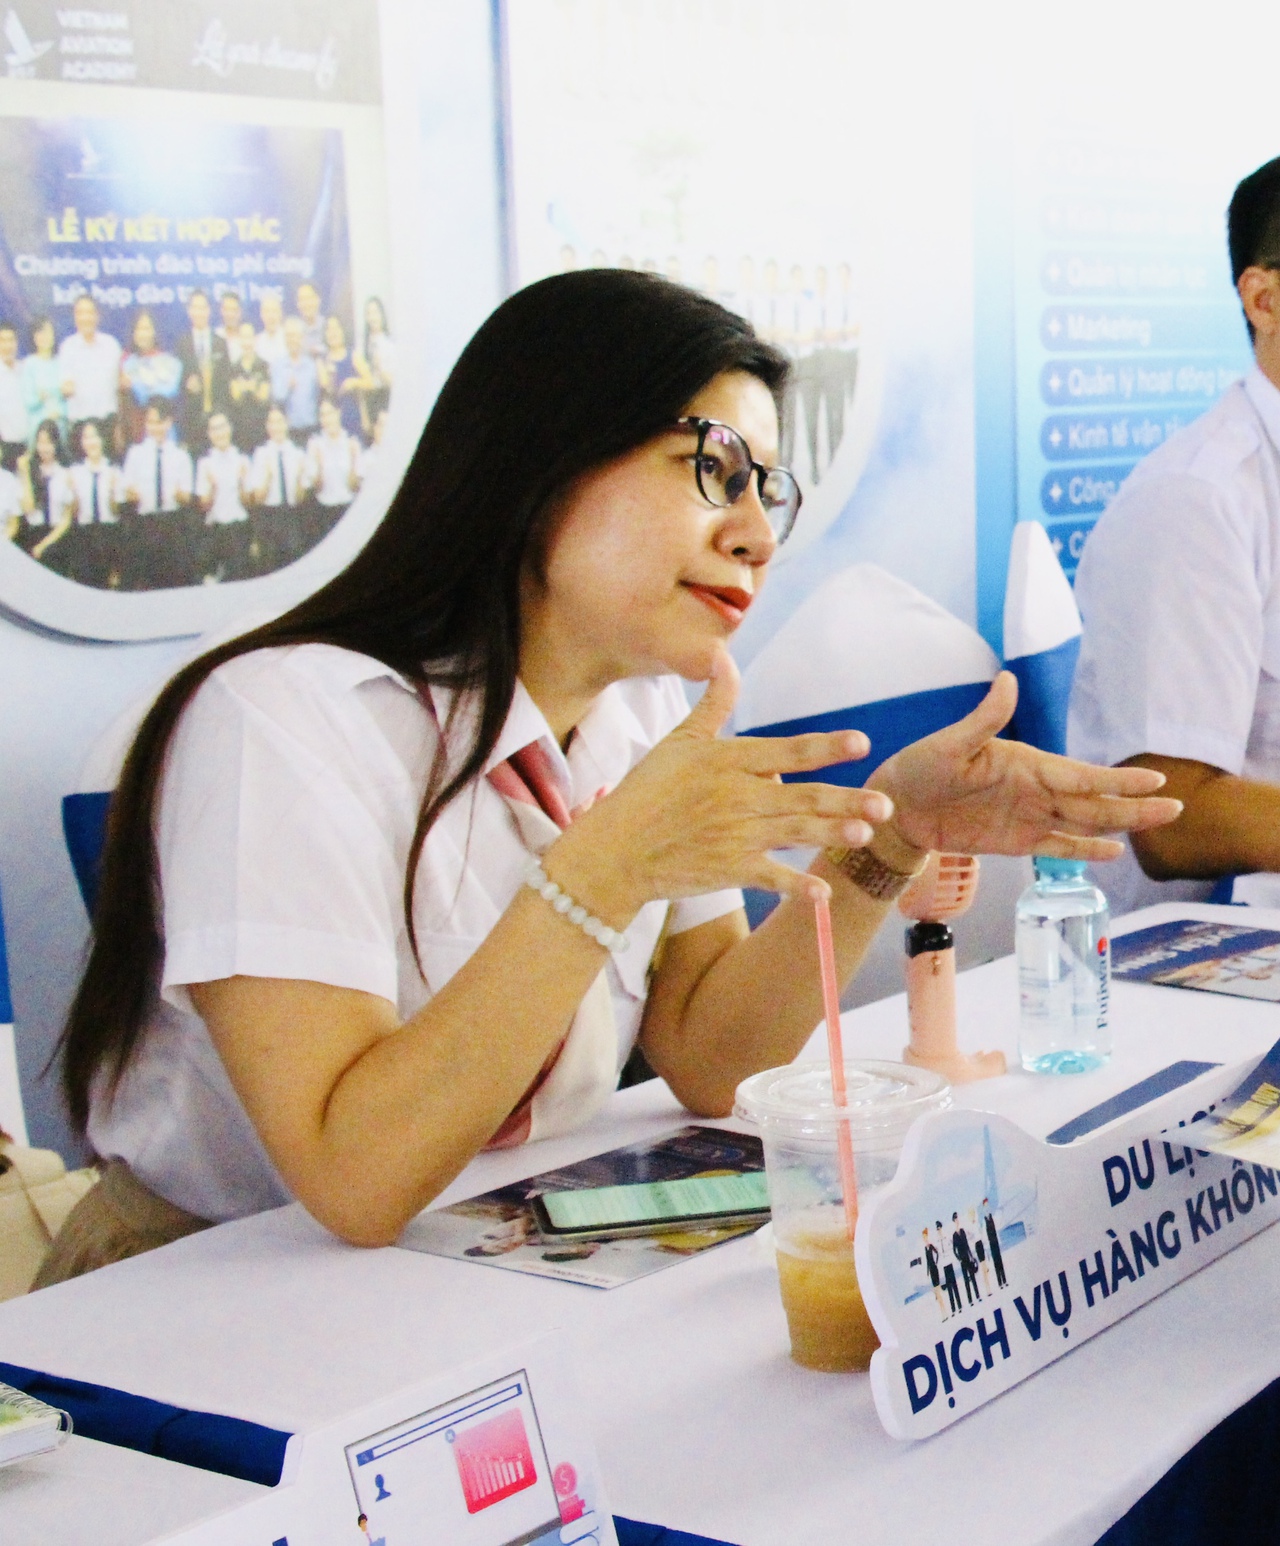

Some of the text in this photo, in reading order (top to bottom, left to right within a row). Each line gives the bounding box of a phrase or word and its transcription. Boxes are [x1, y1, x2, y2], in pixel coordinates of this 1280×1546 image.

[1067, 313, 1151, 348] Marketing
[1068, 422, 1109, 450] Kinh
[1102, 1138, 1155, 1207] DU
[902, 1307, 1011, 1414] DỊCH
[1013, 1270, 1072, 1339] VỤ
[1079, 1210, 1182, 1308] HÀNG
